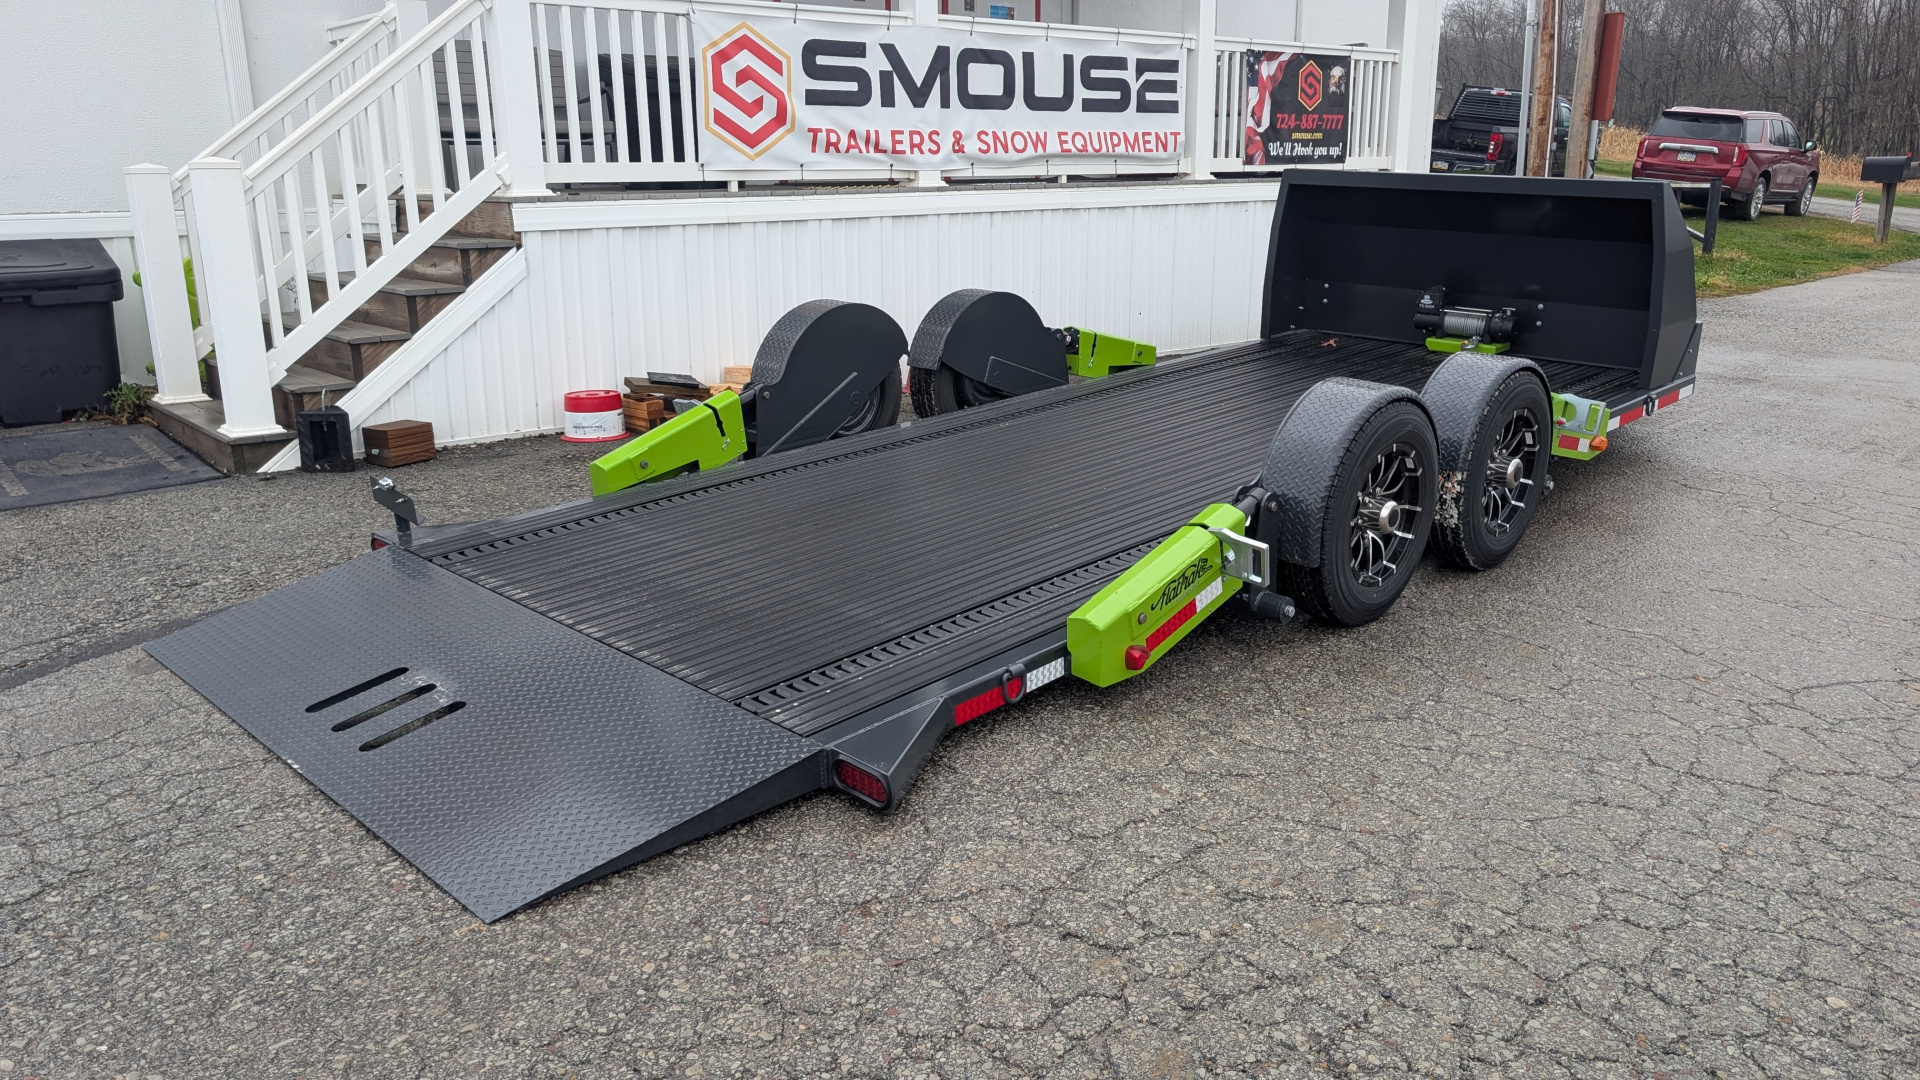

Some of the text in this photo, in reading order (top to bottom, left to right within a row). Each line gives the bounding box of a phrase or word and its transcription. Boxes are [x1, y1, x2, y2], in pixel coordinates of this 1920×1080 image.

[801, 38, 1180, 114] SMOUSE
[1276, 113, 1344, 129] 724-887-7777
[807, 127, 1182, 155] TRAILERS & SNOW EQUIPMENT
[1268, 141, 1343, 159] We'll Hook you up!
